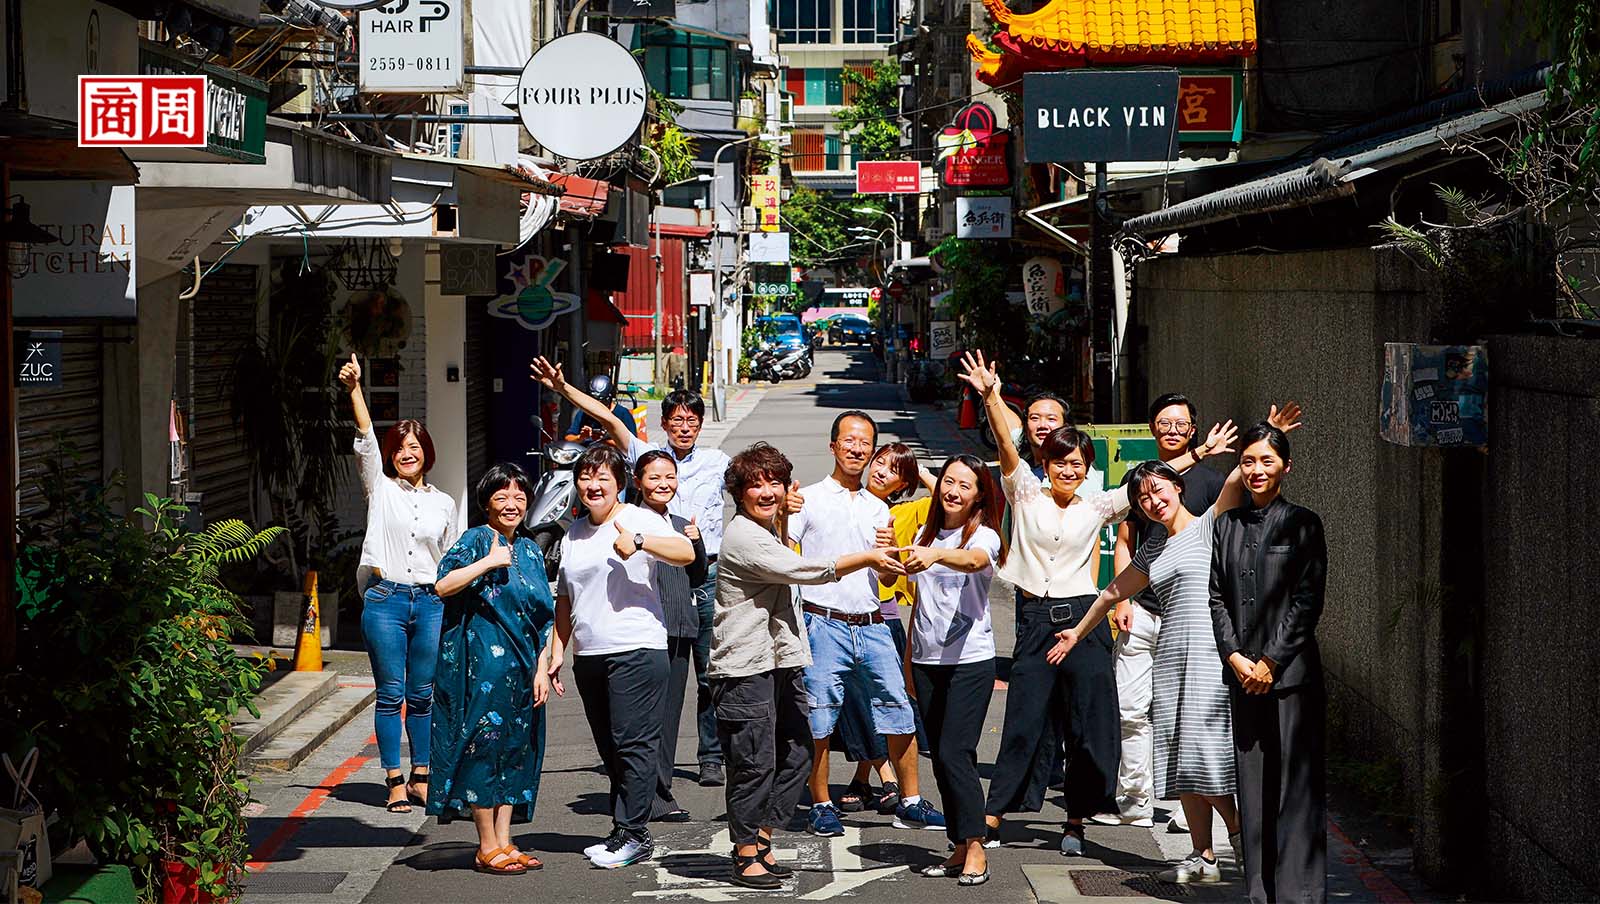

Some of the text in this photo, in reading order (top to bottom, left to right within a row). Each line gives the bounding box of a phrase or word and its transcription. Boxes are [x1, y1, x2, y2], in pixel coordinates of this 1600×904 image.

[371, 20, 413, 33] HAIR
[370, 57, 451, 71] 2559-0811
[522, 87, 644, 105] FOUR PLUS
[1178, 83, 1216, 125] 宮
[1037, 106, 1165, 128] BLACK VIN
[30, 251, 131, 274] TCHEN
[19, 363, 53, 377] ZUC
